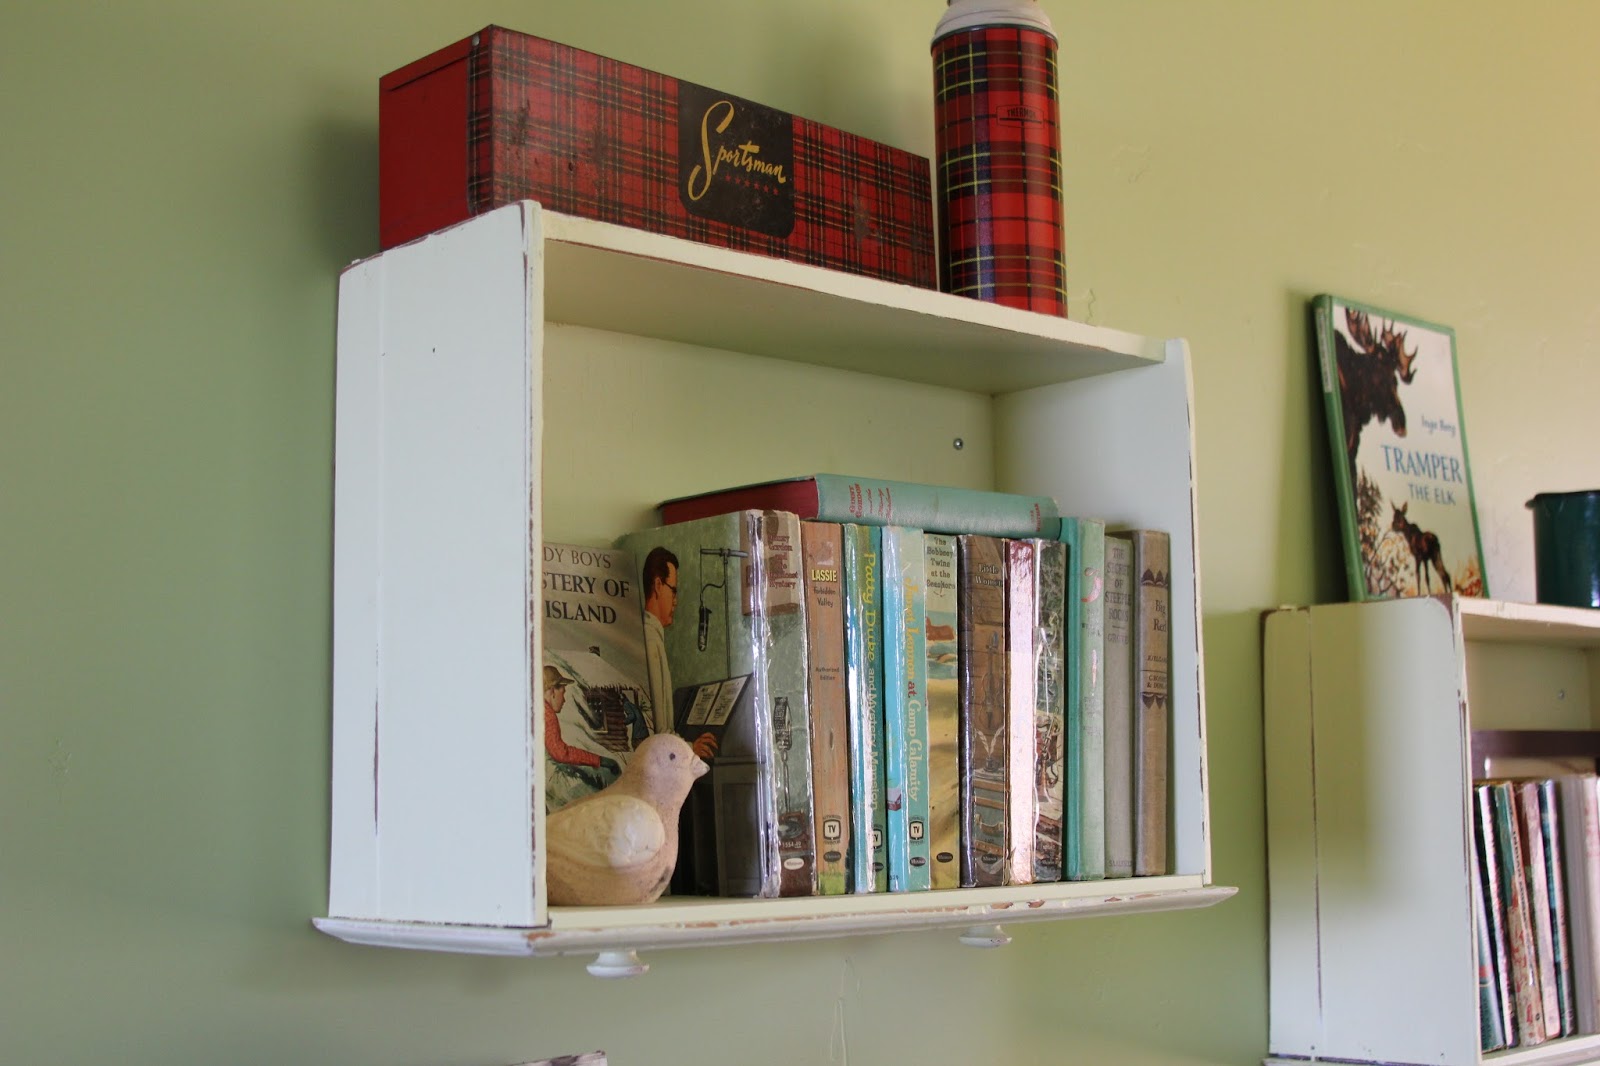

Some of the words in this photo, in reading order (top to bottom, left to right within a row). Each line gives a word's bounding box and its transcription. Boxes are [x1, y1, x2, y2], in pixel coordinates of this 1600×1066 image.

[688, 100, 786, 200] Sportsman
[1380, 444, 1463, 483] TRAMPER
[1408, 482, 1430, 502] THE
[1434, 487, 1456, 506] ELK
[934, 537, 947, 546] The
[571, 551, 611, 569] BOYS
[927, 547, 953, 558] Bobbsey
[931, 558, 950, 568] Twins
[811, 569, 837, 582] LASSIE
[862, 552, 876, 604] Patty
[939, 570, 950, 578] the
[604, 578, 630, 598] OF
[813, 586, 836, 595] Forbidden
[1114, 579, 1123, 589] OF
[817, 597, 834, 608] Valley
[1155, 600, 1166, 616] Big
[545, 600, 617, 625] ISLAND
[1153, 619, 1167, 632] Red
[865, 610, 877, 661] Duke
[906, 627, 919, 680] Lennon
[868, 668, 878, 691] and
[907, 681, 918, 698] at
[908, 699, 922, 738] Camp
[908, 739, 922, 801] Calamity
[827, 824, 837, 834] TV
[913, 826, 920, 834] TV
